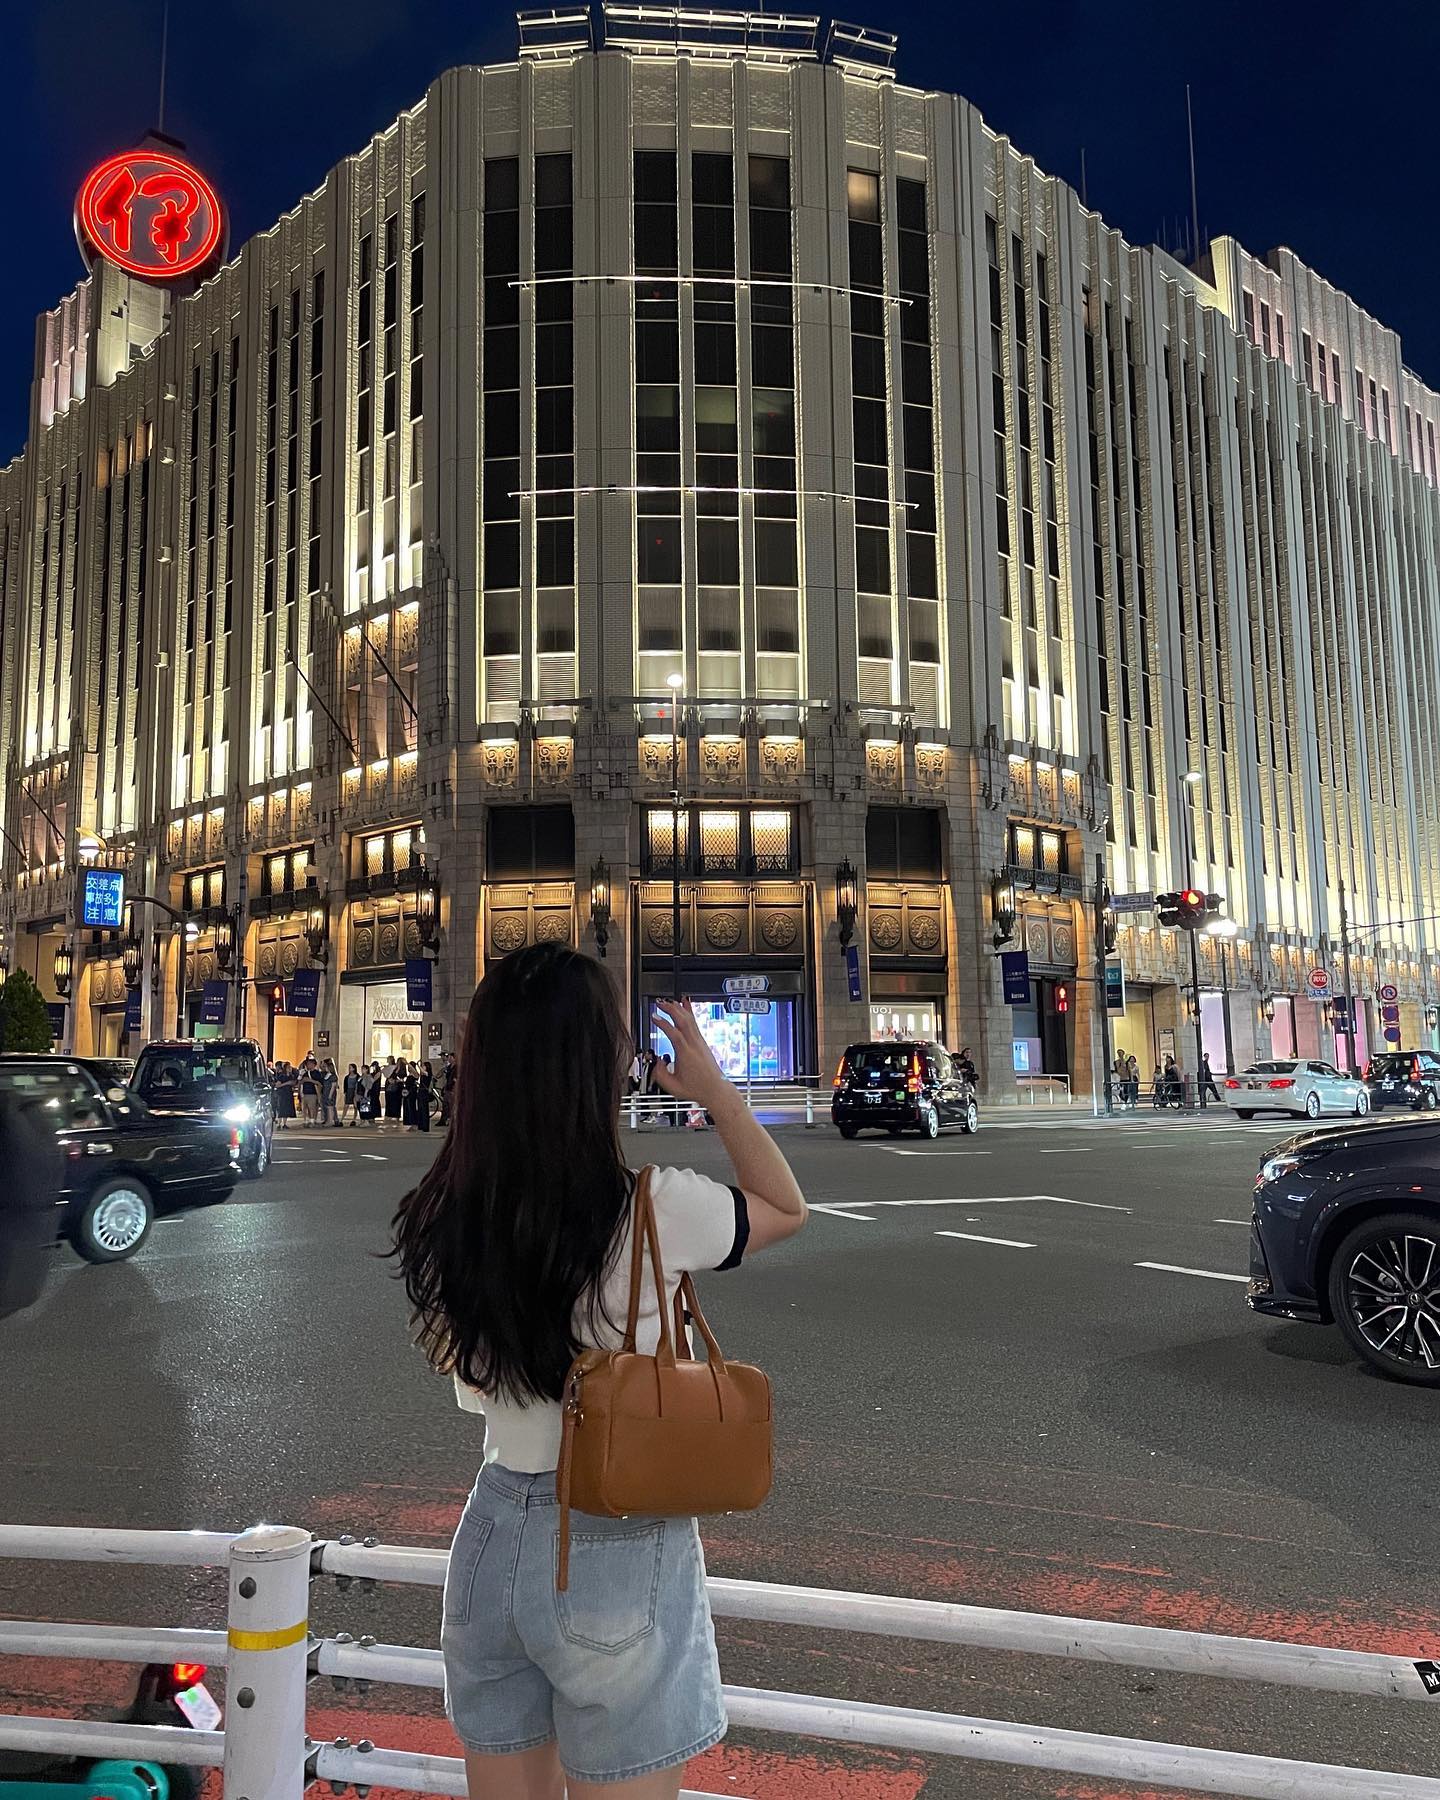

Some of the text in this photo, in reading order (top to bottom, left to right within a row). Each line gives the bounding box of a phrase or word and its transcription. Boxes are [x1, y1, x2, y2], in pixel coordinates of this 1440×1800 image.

[86, 877, 121, 891] 交差点
[86, 892, 119, 906] 事故多し
[87, 907, 117, 920] 注意
